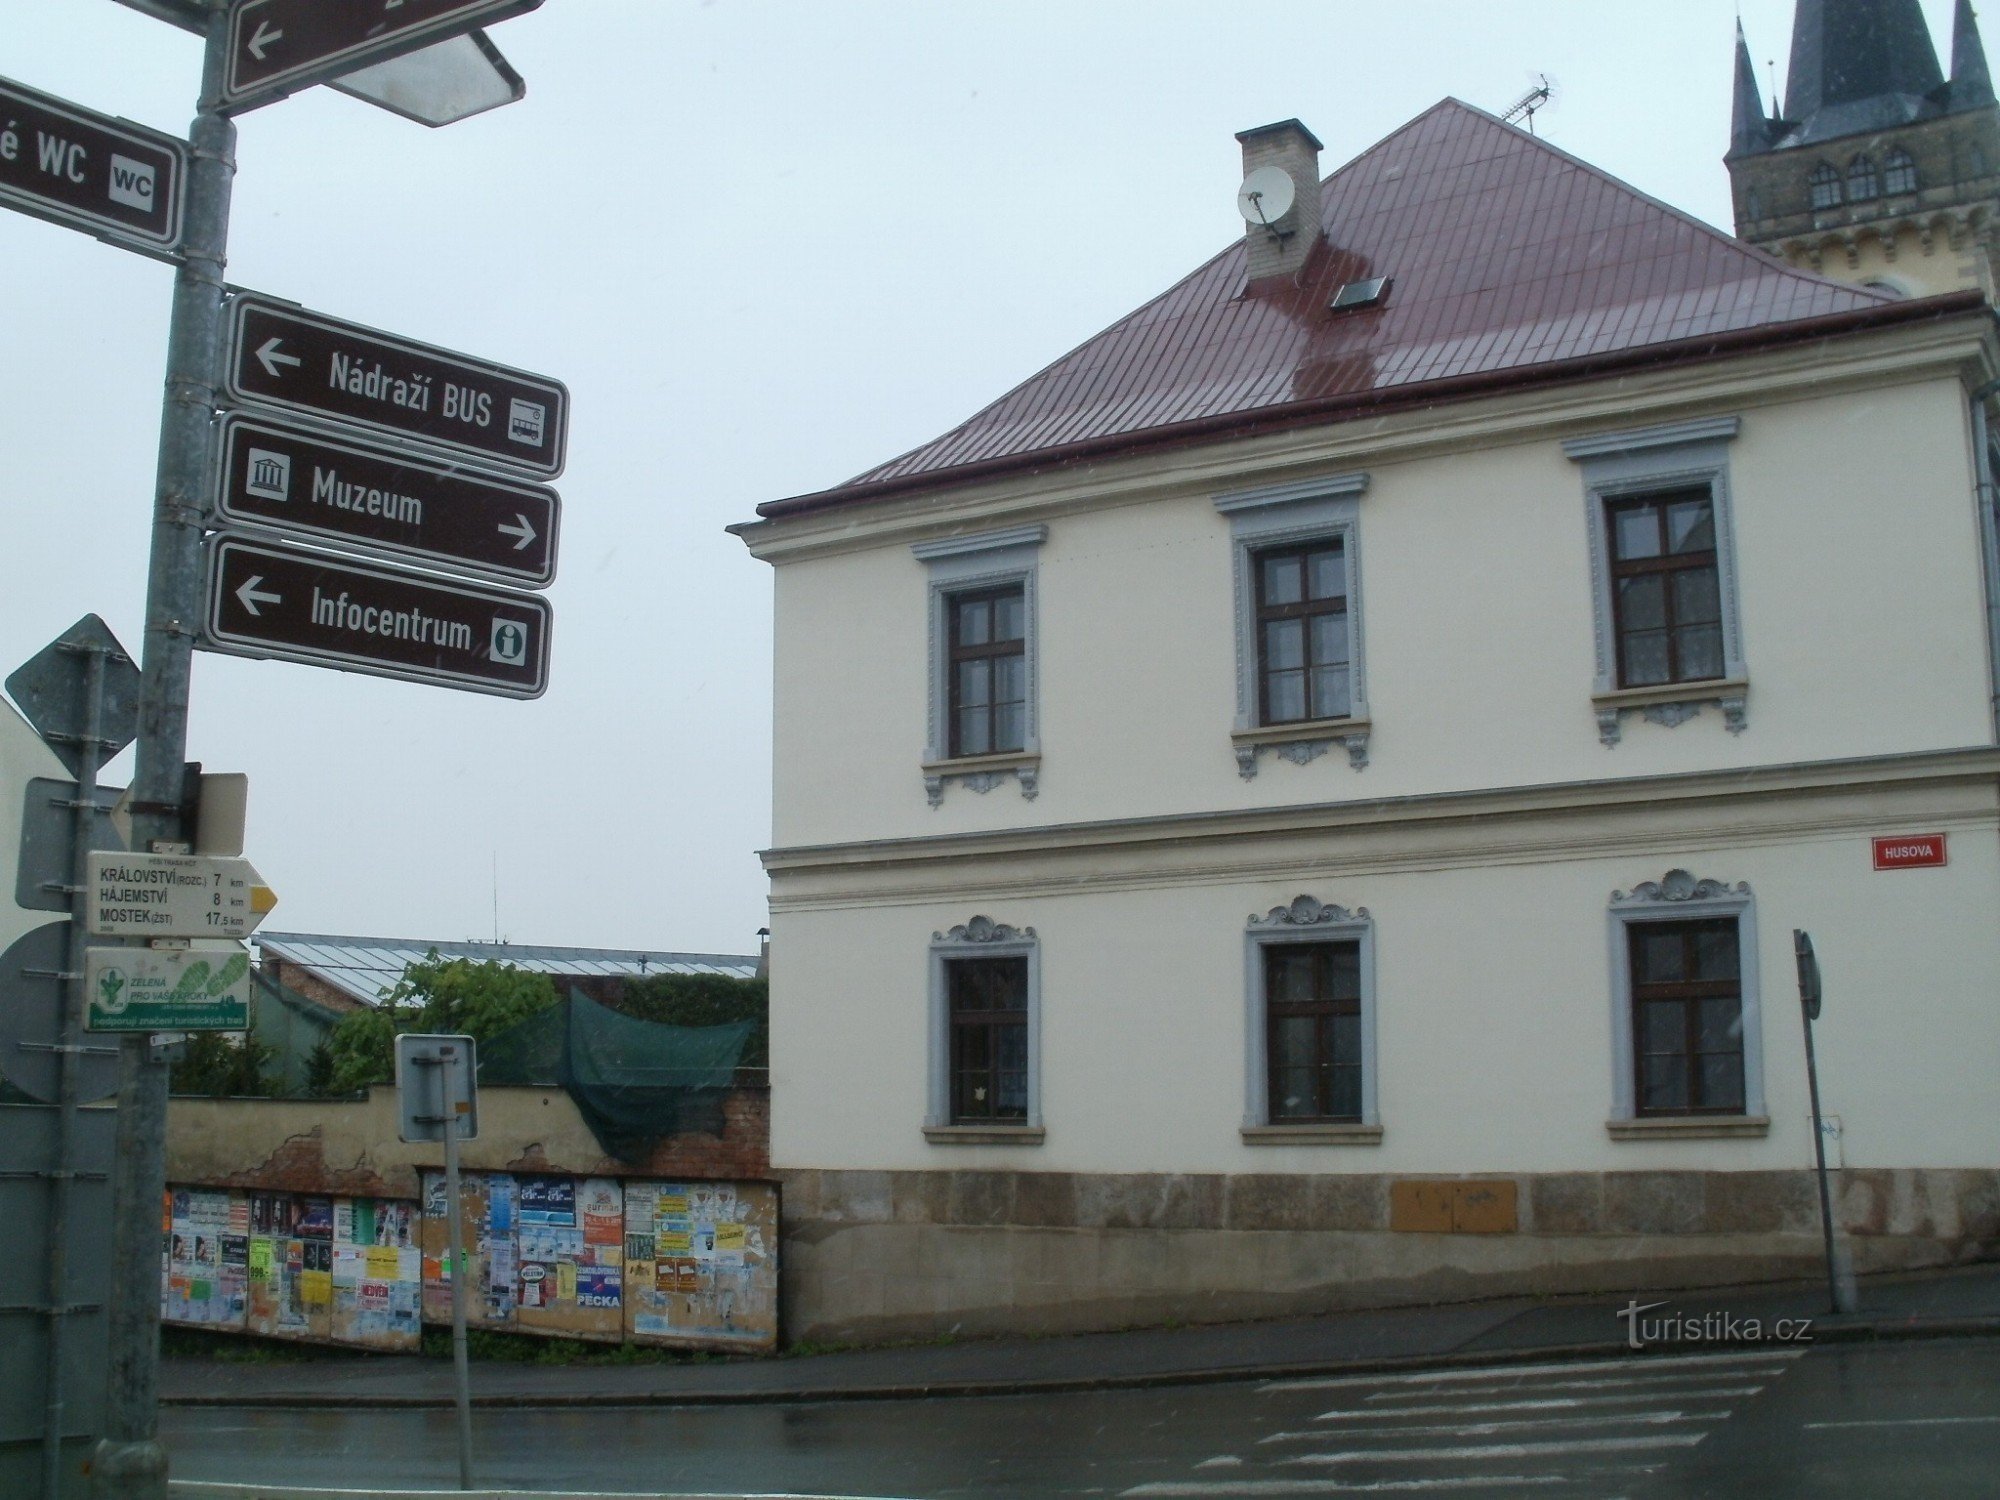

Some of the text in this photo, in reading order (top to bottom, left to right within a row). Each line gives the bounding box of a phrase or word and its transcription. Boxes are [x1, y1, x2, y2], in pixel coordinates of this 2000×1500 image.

[37, 130, 86, 183] WC
[113, 166, 151, 197] WC
[329, 351, 492, 427] Nádraží BUS
[311, 466, 422, 525] Muzeum
[310, 586, 473, 651] Infocentrum
[1885, 845, 1934, 859] HUSOVA
[100, 867, 176, 885] KRÁLOVSTVÍ
[214, 873, 222, 887] 7
[230, 879, 244, 888] km
[100, 886, 244, 907] HÁJEMSTVÍ 8 km
[100, 908, 150, 923] MOSTEK
[230, 916, 244, 926] km
[130, 976, 167, 987] ZELENÁ
[130, 992, 150, 1001] PRO
